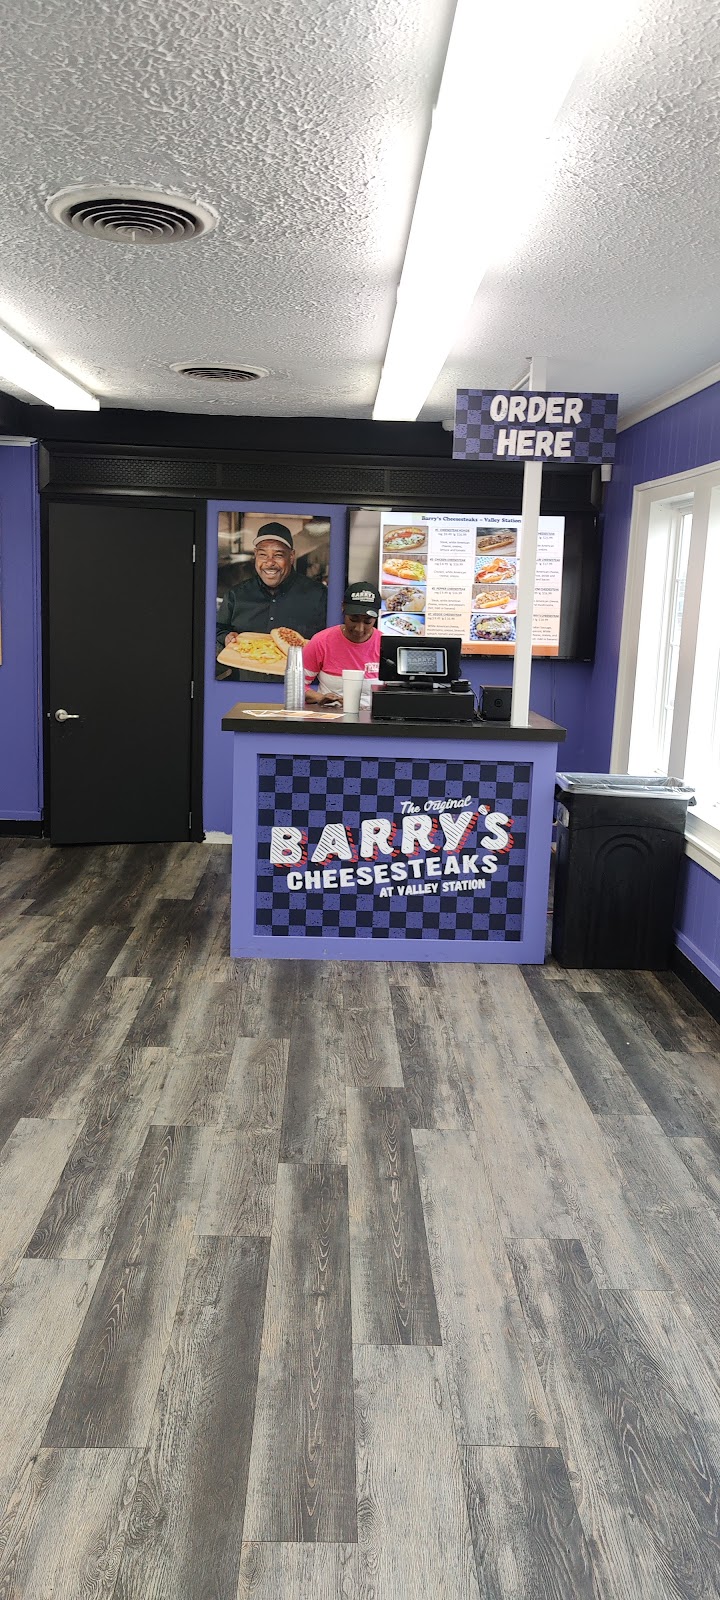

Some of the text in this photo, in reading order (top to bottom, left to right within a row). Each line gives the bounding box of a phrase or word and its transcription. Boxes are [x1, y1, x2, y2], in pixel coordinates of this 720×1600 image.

[490, 395, 584, 425] ORDER
[496, 429, 574, 458] HERE
[421, 515, 442, 523] Barry's
[400, 795, 472, 815] The Original
[270, 804, 513, 867] BARRY'S
[287, 854, 498, 891] CHEESESTEAKS
[379, 878, 486, 898] AT VALLEY STATION
